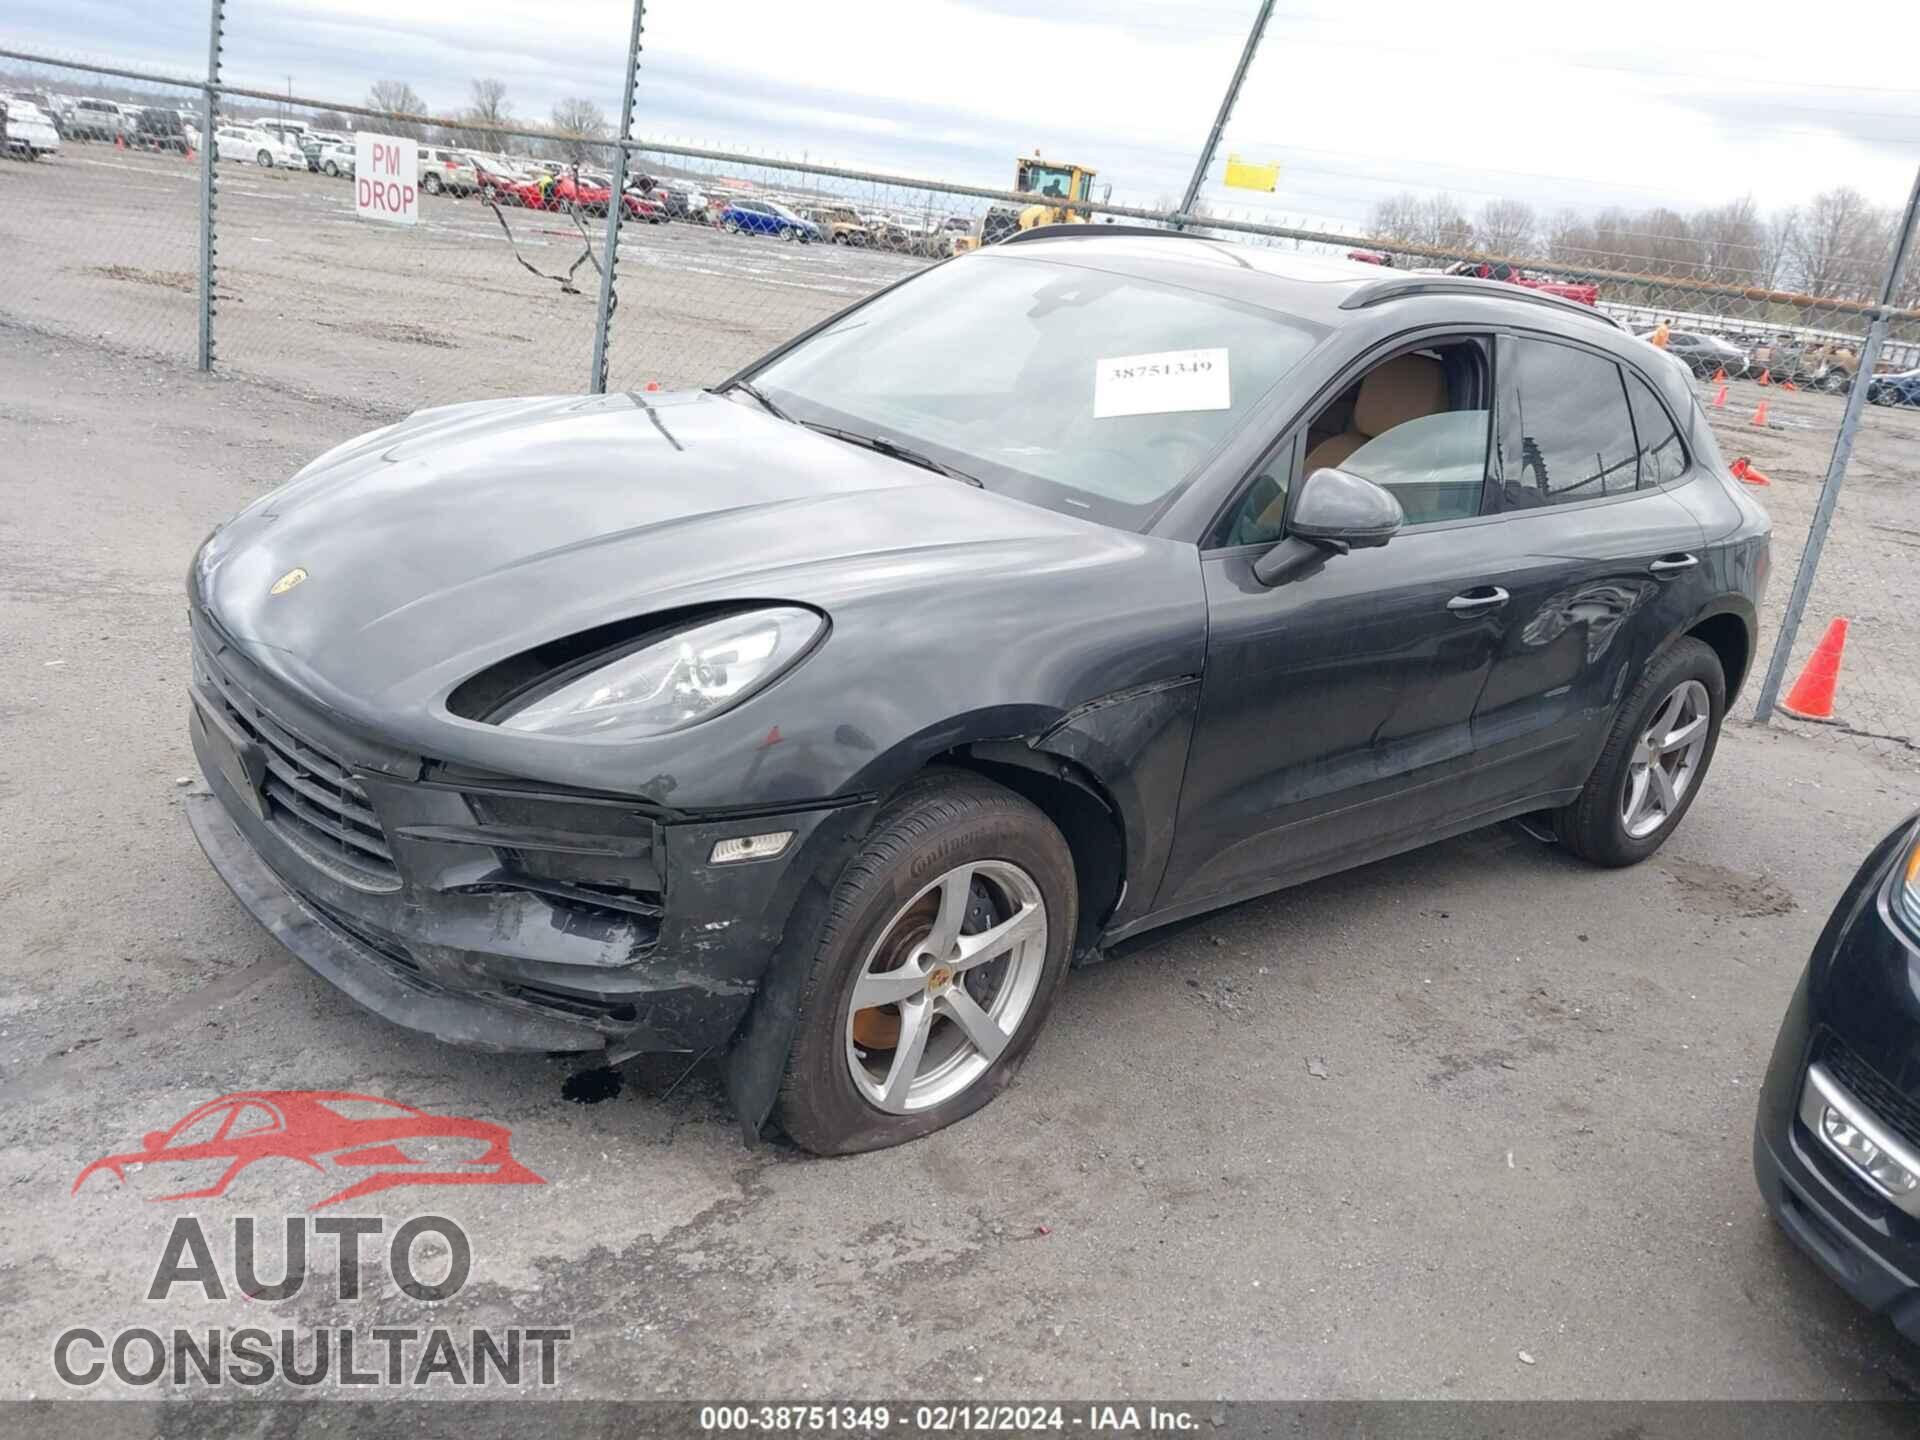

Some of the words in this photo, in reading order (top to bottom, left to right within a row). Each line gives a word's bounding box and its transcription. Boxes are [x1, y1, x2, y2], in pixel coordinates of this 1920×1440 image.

[373, 143, 400, 176] PM
[359, 178, 414, 214] DROP
[1109, 361, 1213, 383] 38751349
